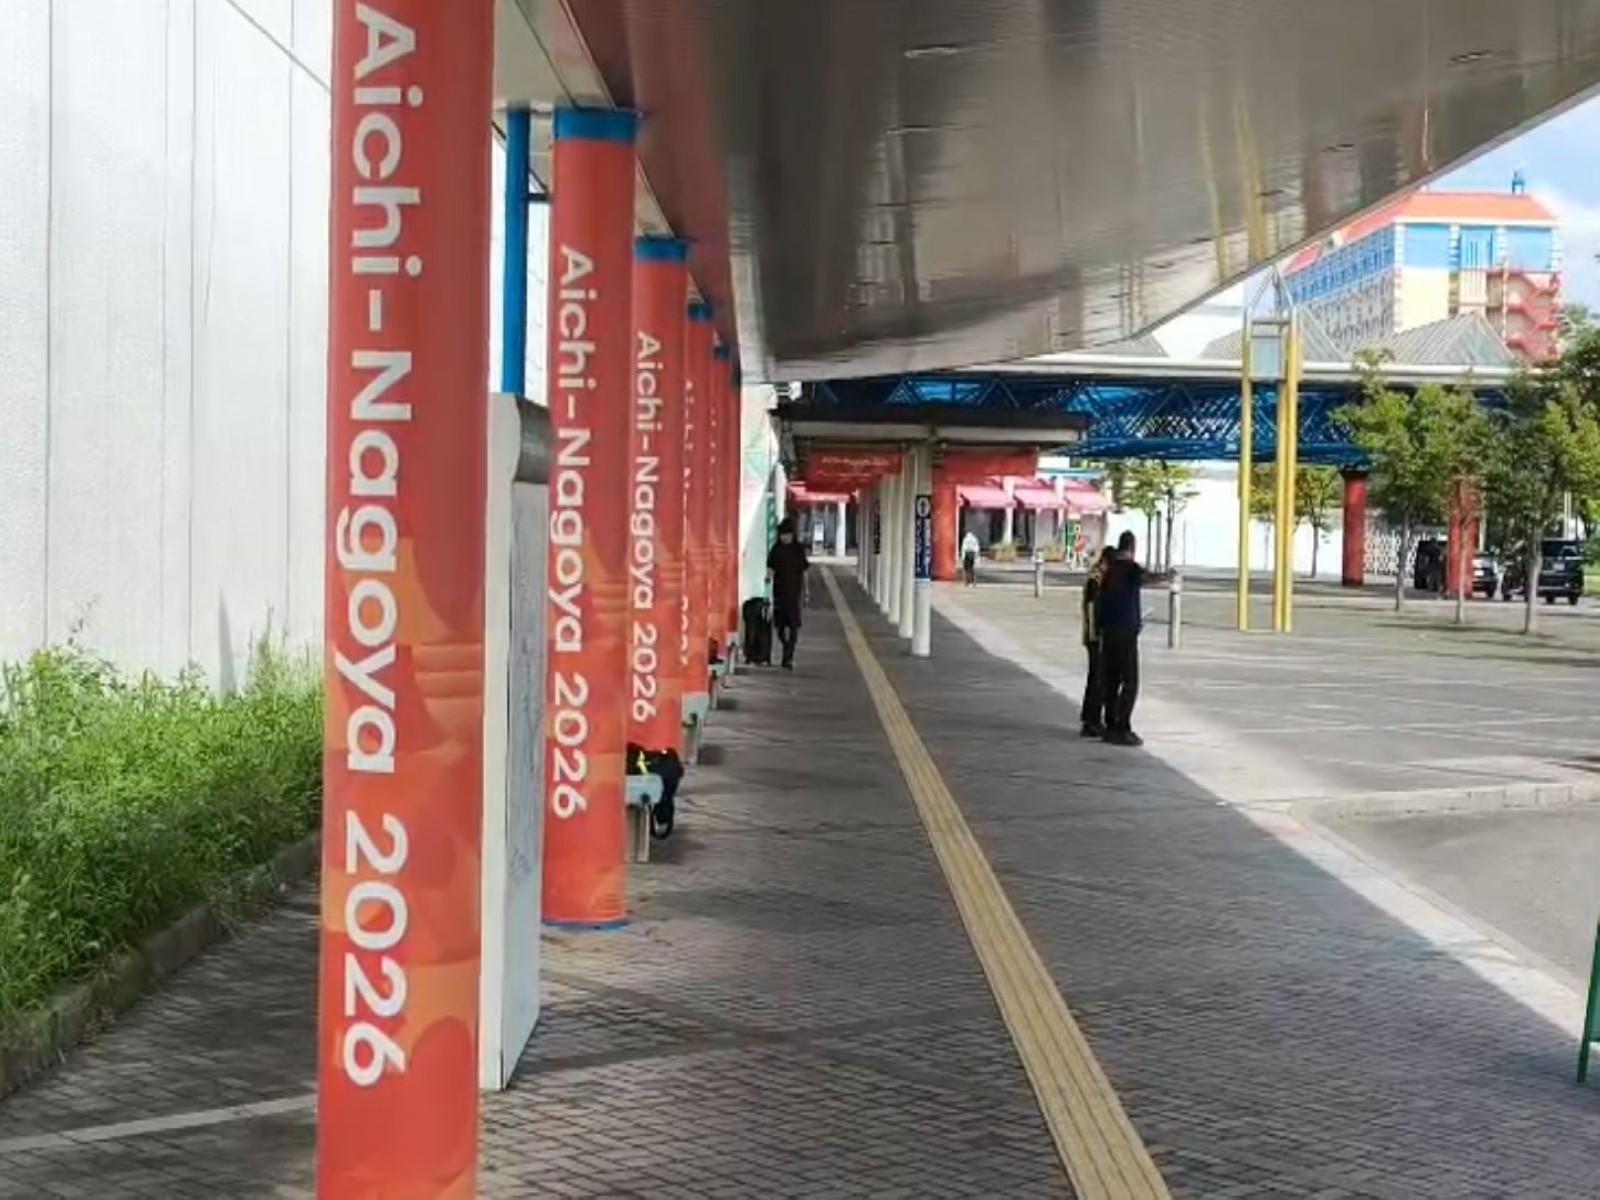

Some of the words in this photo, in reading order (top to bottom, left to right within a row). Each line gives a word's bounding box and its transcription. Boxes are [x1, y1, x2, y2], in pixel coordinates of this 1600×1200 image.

[335, 2, 423, 774] Aichi-Nagoya
[549, 242, 598, 653] Aichi-Nagoya
[630, 330, 664, 610] Aichi-Nagoya
[552, 671, 589, 819] 2026
[632, 621, 658, 724] 2026
[343, 809, 409, 1086] 2026
